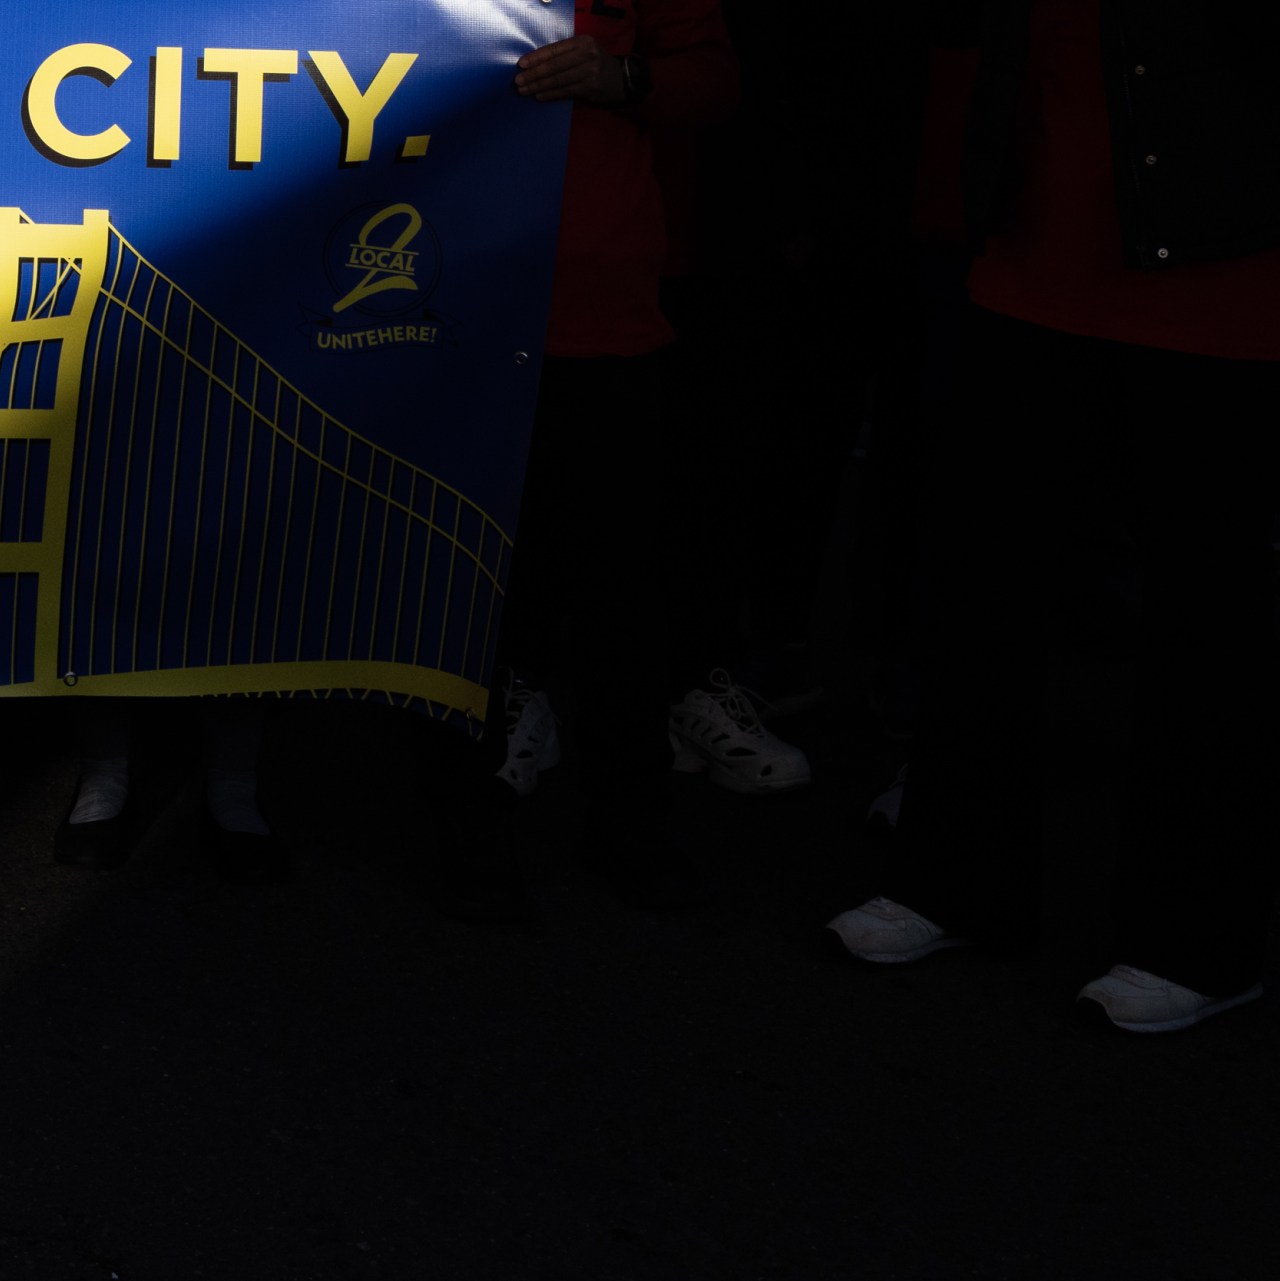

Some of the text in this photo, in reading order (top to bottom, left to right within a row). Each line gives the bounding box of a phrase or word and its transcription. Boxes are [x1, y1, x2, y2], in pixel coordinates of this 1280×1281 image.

[25, 43, 430, 164] CITY.
[349, 247, 415, 272] LOCAL
[317, 326, 437, 349] UNITEHERE!
